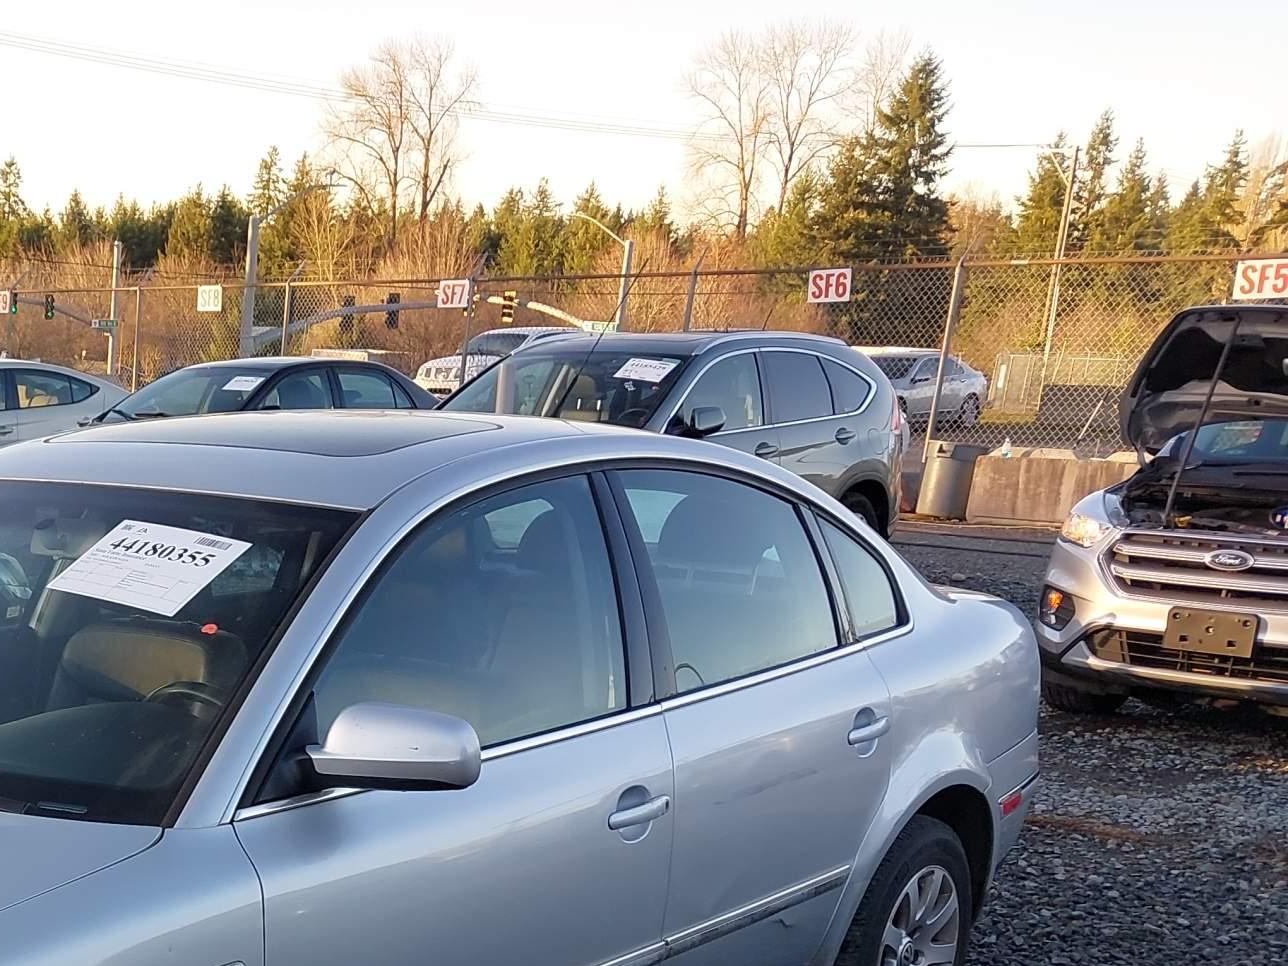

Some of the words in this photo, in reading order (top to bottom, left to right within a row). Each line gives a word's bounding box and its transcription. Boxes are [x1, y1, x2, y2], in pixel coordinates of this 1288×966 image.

[811, 271, 848, 299] SF6
[1239, 263, 1288, 295] SF5
[200, 289, 220, 308] SF8
[441, 283, 466, 305] SF7
[110, 536, 217, 567] 44180355
